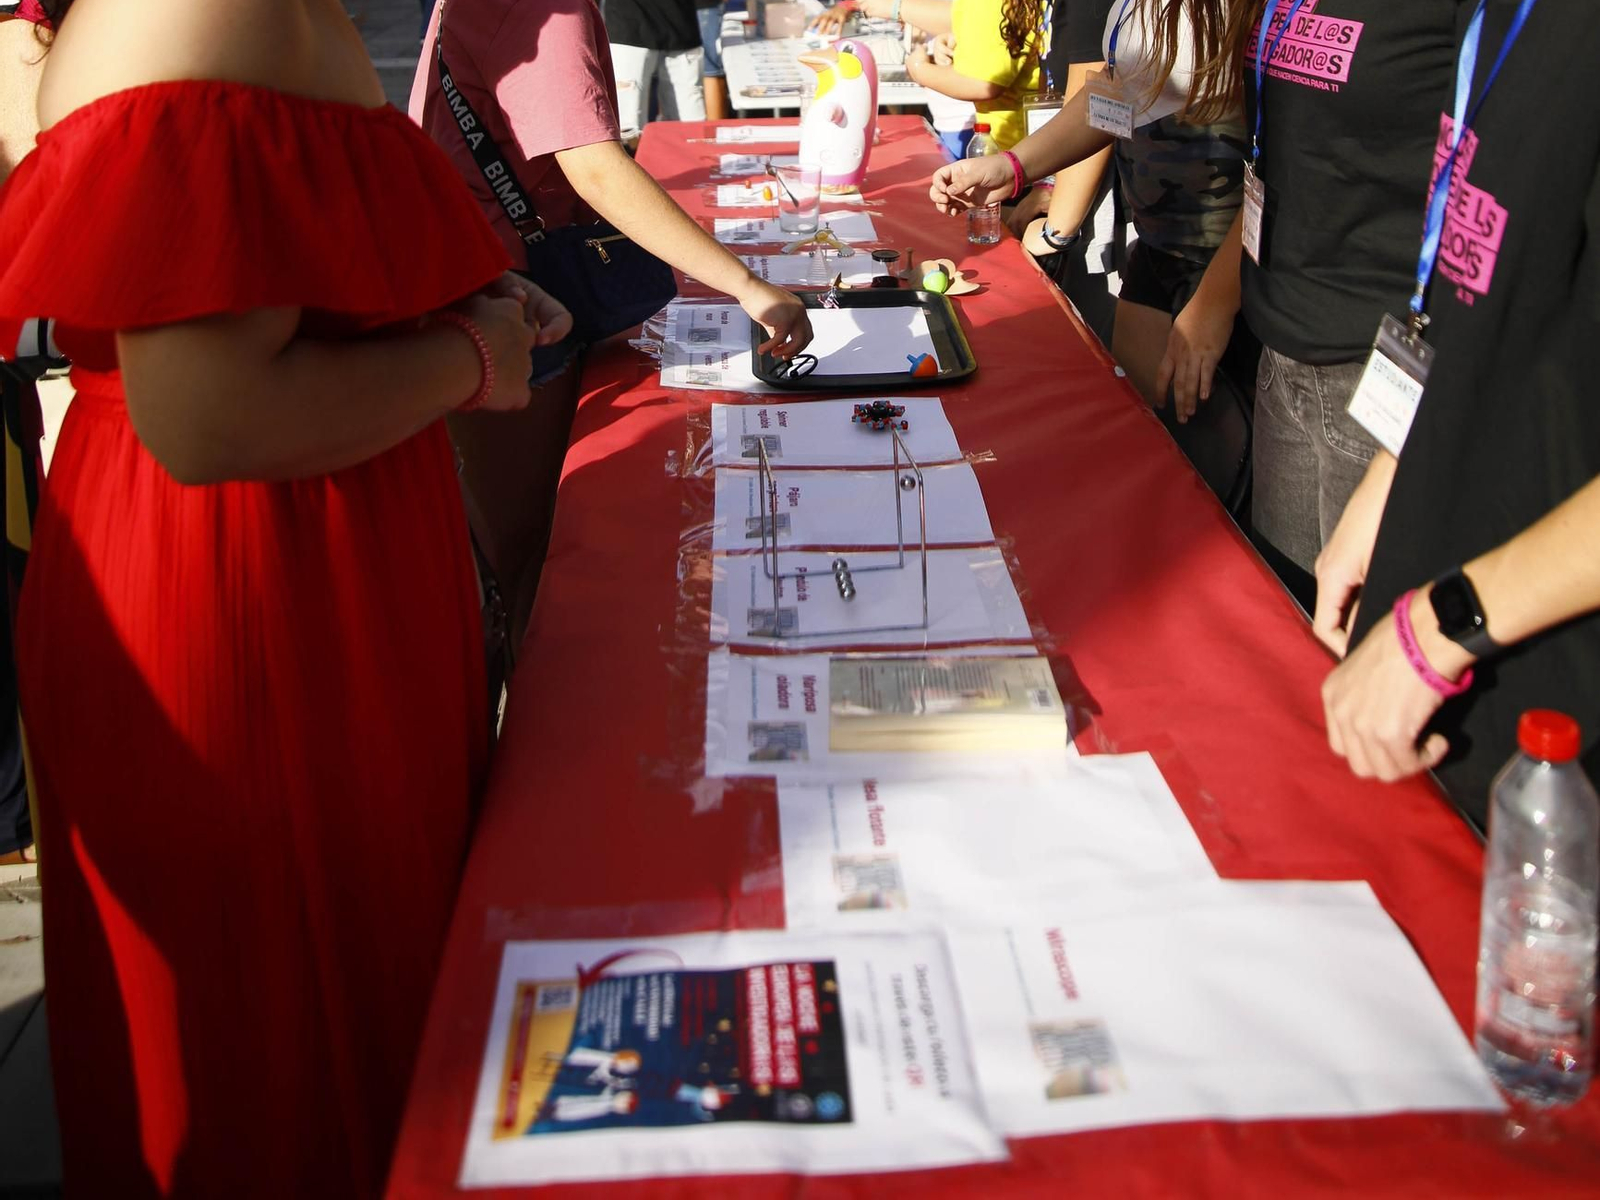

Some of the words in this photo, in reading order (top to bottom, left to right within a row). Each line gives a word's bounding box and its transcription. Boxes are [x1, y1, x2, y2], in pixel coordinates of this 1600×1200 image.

[1295, 16, 1315, 38] DE
[1313, 20, 1355, 45] L@S
[441, 73, 485, 150] BIMBA
